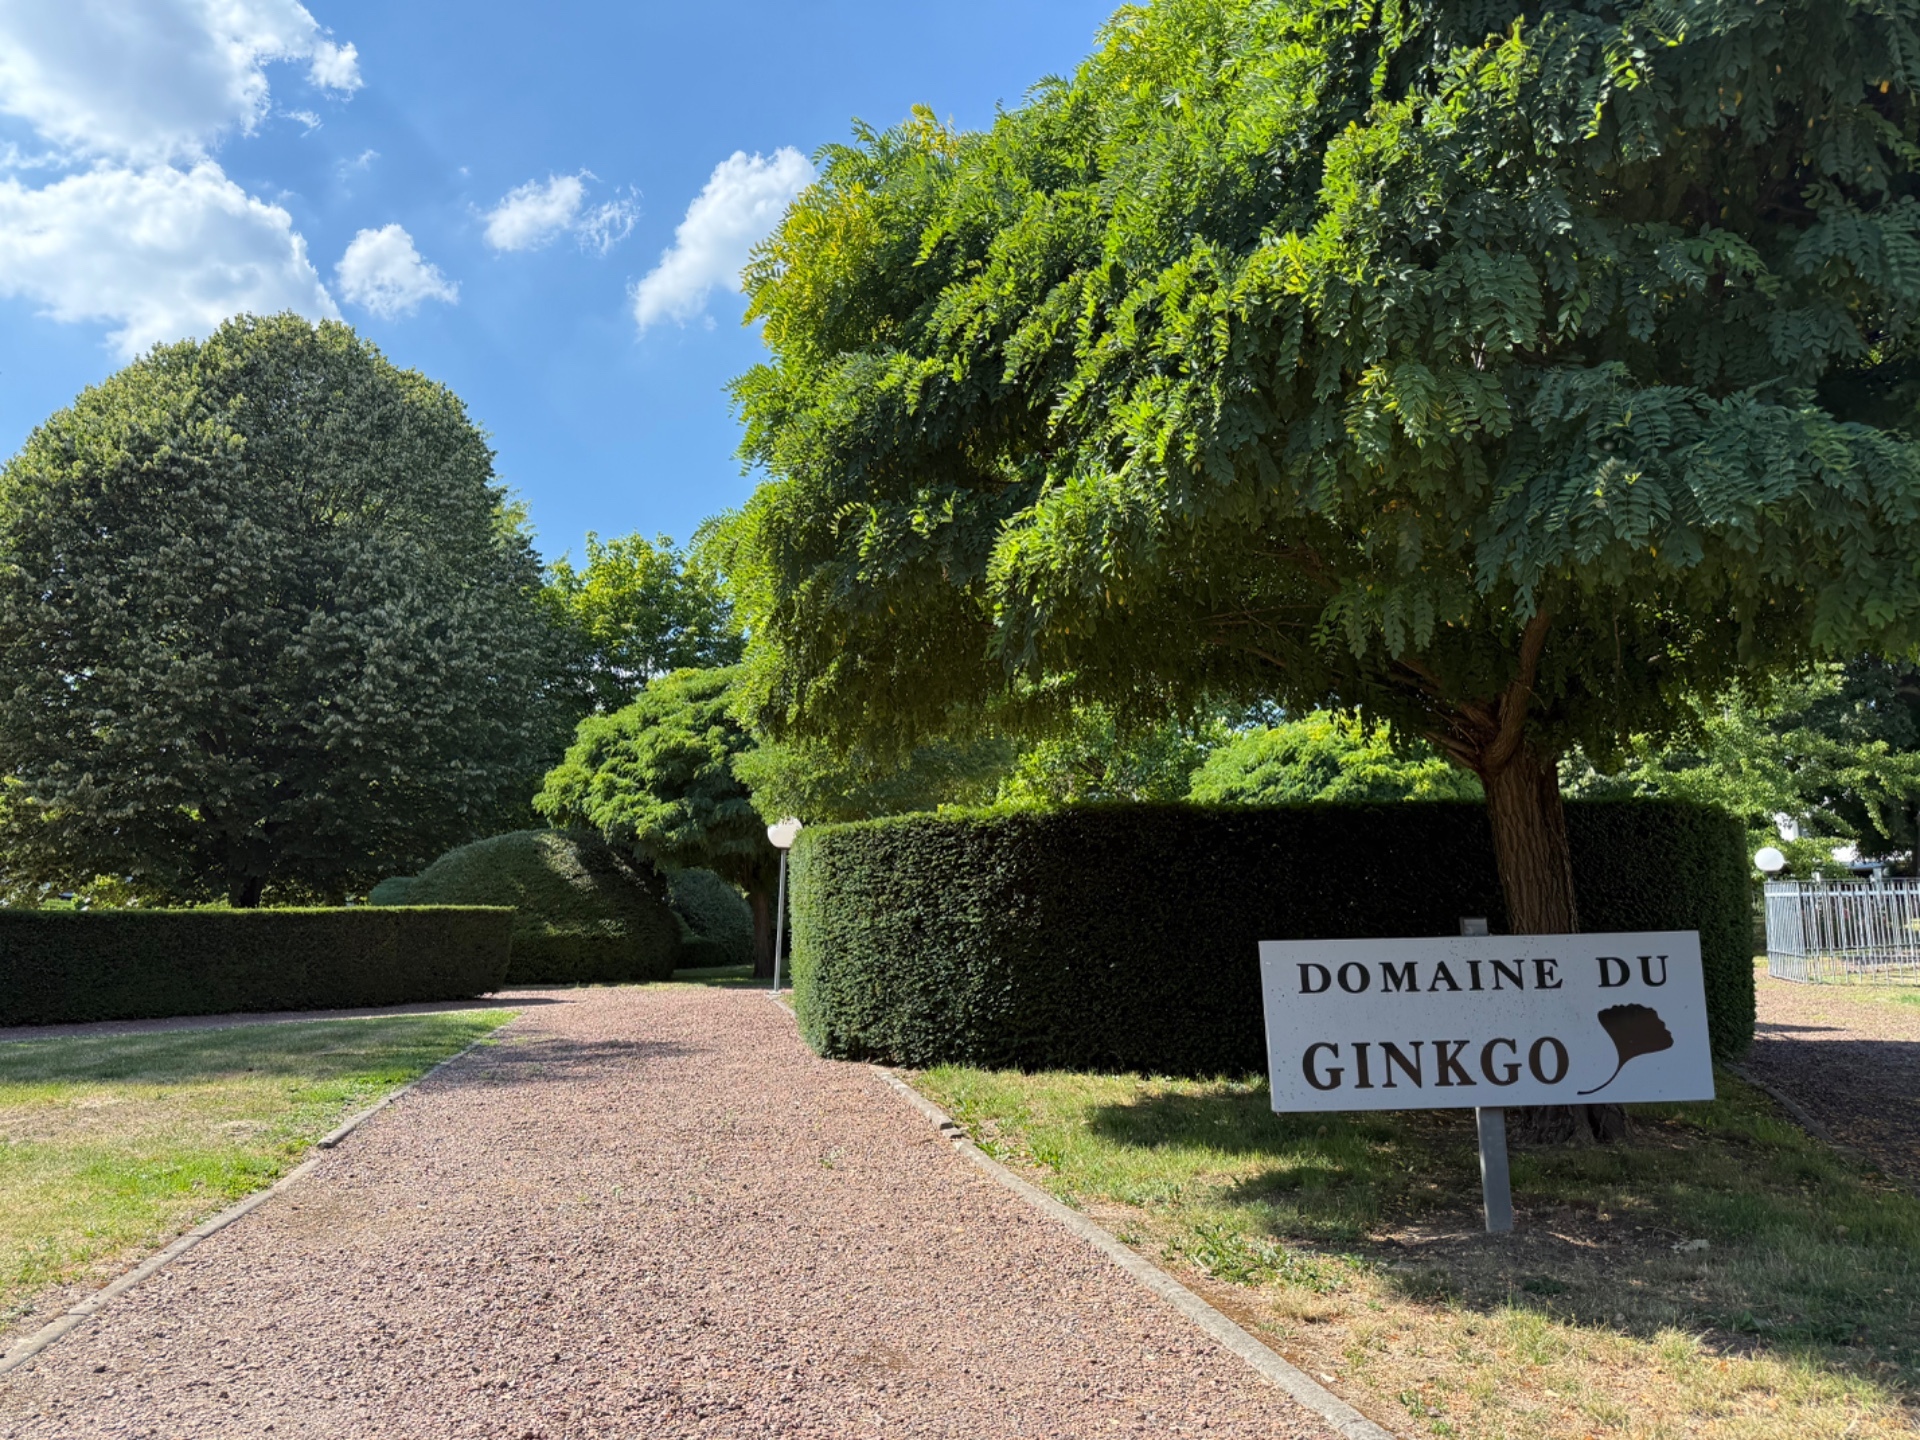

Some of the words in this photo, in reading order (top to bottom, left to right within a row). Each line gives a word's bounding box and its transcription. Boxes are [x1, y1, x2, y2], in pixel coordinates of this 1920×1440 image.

[1296, 958, 1564, 995] DOMAINE
[1595, 955, 1670, 989] DU
[1302, 1036, 1570, 1091] GINKGO
